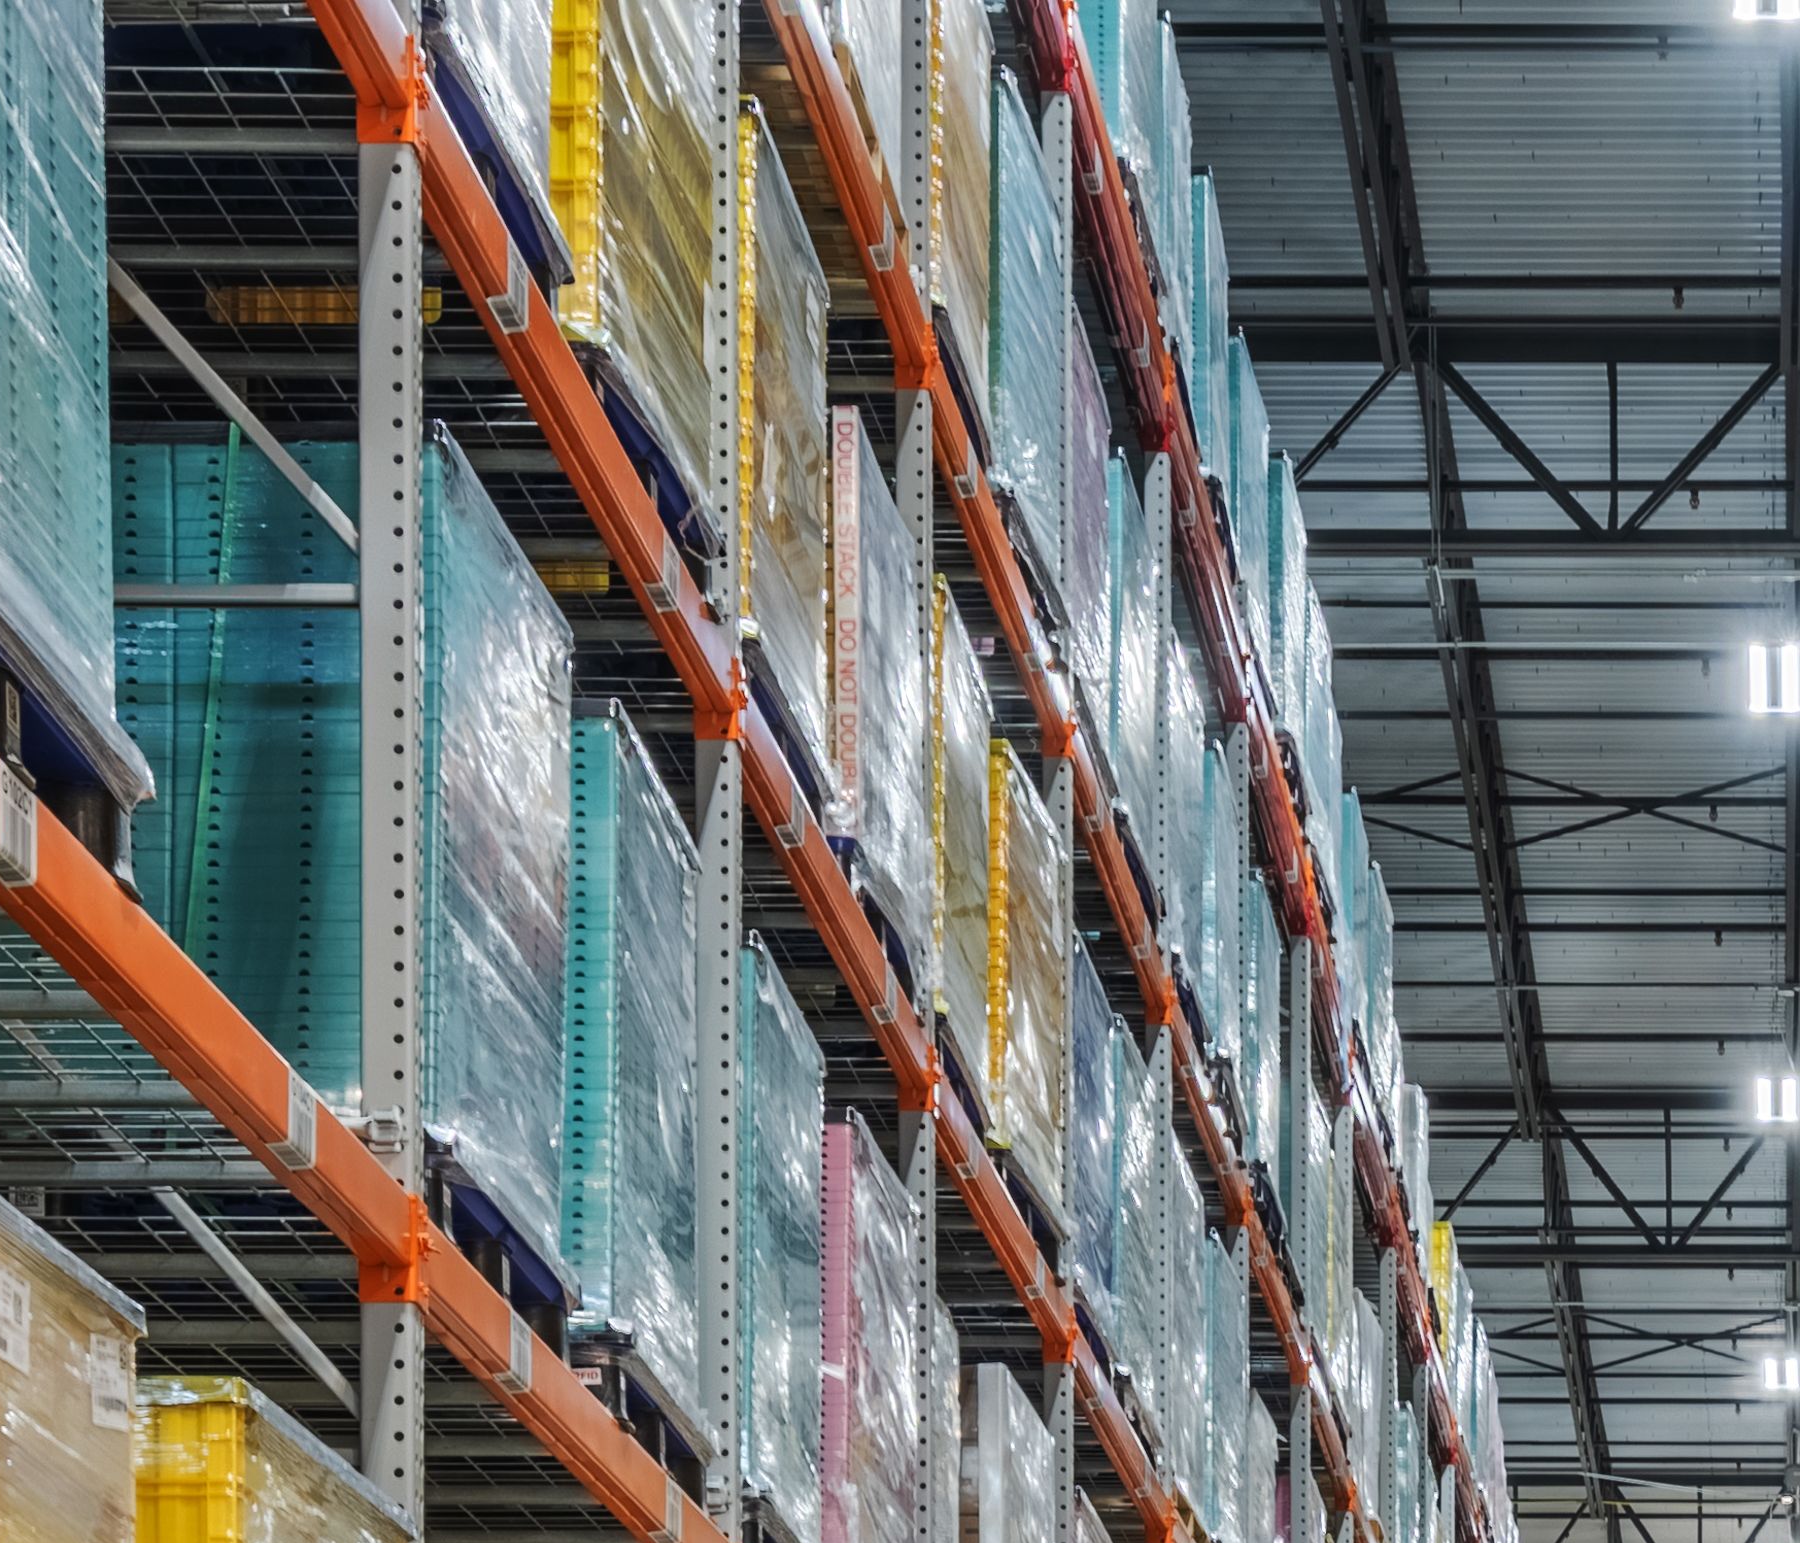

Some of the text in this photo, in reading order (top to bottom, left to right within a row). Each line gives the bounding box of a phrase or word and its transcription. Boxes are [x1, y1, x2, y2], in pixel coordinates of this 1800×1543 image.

[839, 523, 857, 598] STACK
[839, 619, 857, 652] DO
[839, 660, 857, 705] NOT
[839, 713, 857, 800] DOUB
[2, 770, 33, 818] G102C1
